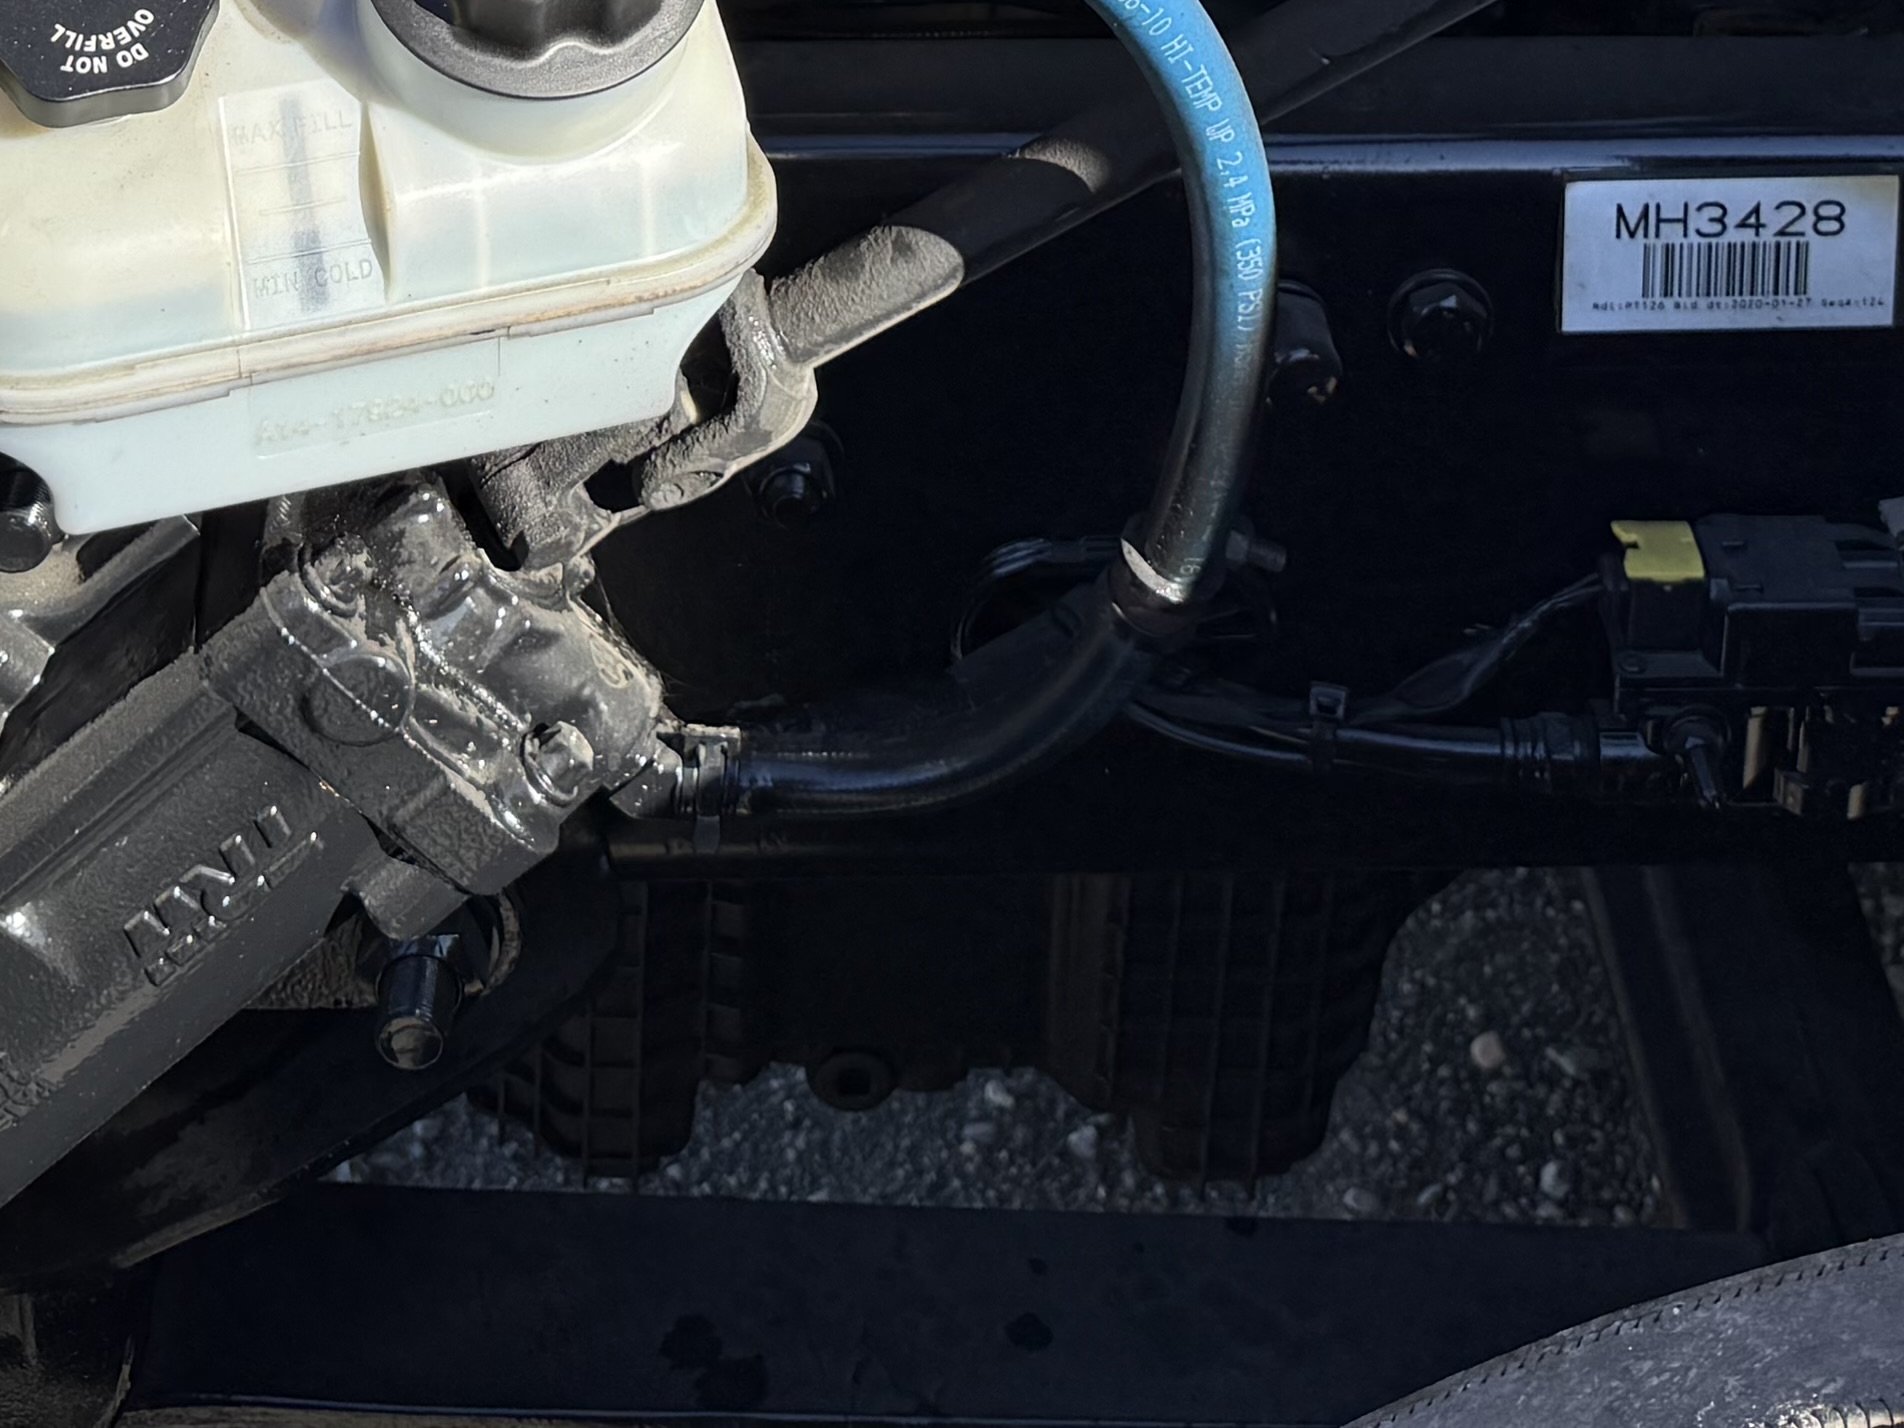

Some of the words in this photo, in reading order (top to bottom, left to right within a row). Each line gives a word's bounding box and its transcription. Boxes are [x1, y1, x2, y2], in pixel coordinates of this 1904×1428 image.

[51, 8, 156, 52] OVERFILL
[60, 53, 108, 74] NOT
[117, 42, 150, 68] DO
[1160, 34, 1222, 114] HI-TEMP
[1229, 192, 1256, 229] MPa
[1614, 199, 1847, 240] MH3428
[254, 268, 300, 299] MIN
[312, 256, 374, 289] COLD
